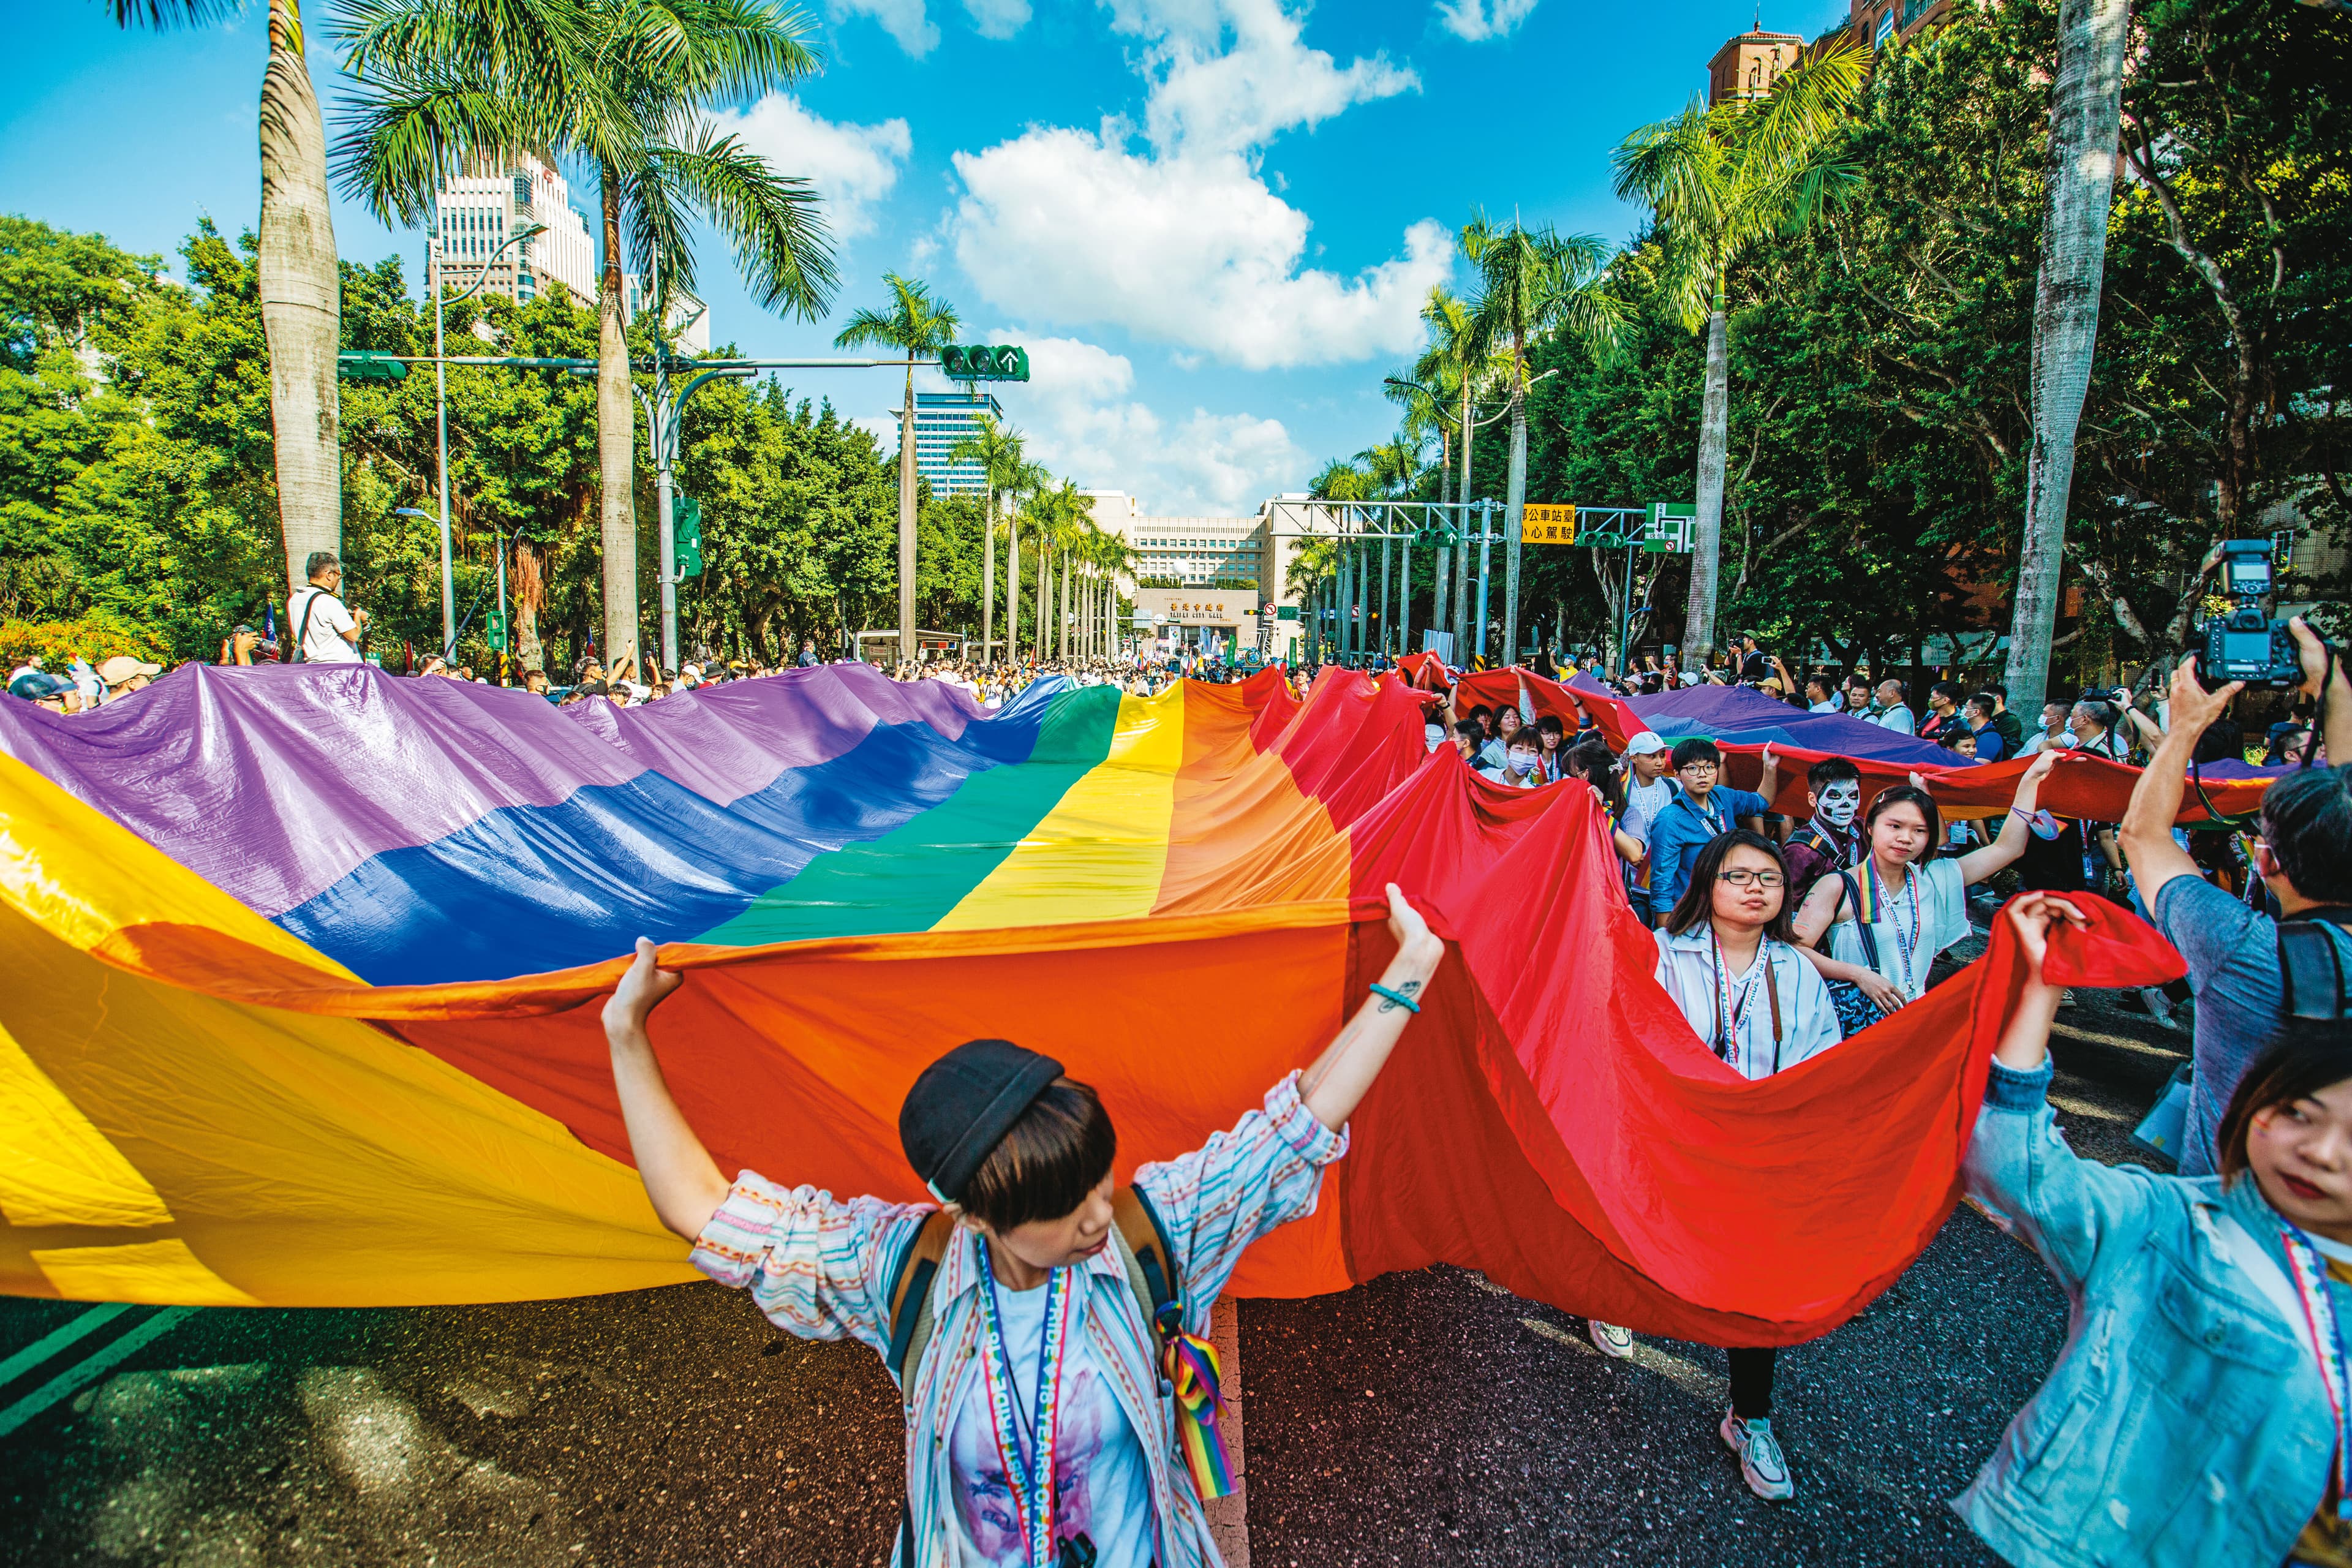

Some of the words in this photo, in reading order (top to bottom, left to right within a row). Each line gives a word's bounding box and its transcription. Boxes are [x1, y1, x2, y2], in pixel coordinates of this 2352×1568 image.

[1521, 526, 1572, 540] 小心駕駛
[1887, 904, 1902, 929] PRIDE
[1897, 929, 1907, 948] LGBT
[1901, 948, 1912, 978] TAIWAN
[1723, 995, 1732, 1027] YEARS
[1738, 1008, 1751, 1031] LGBT
[1745, 981, 1760, 1007] PRIDE
[1755, 962, 1765, 972] 18
[1725, 1029, 1735, 1042] OF
[1727, 1042, 1738, 1063] AGE
[1044, 1294, 1066, 1359] PRIDE
[987, 1331, 1001, 1353] 18
[1039, 1382, 1057, 1404] 18
[992, 1377, 1014, 1444] PRIDE
[1035, 1411, 1054, 1484] YEARS
[1001, 1449, 1029, 1493] LGBT
[1035, 1490, 1051, 1519] OF
[1033, 1522, 1050, 1567] AGE
